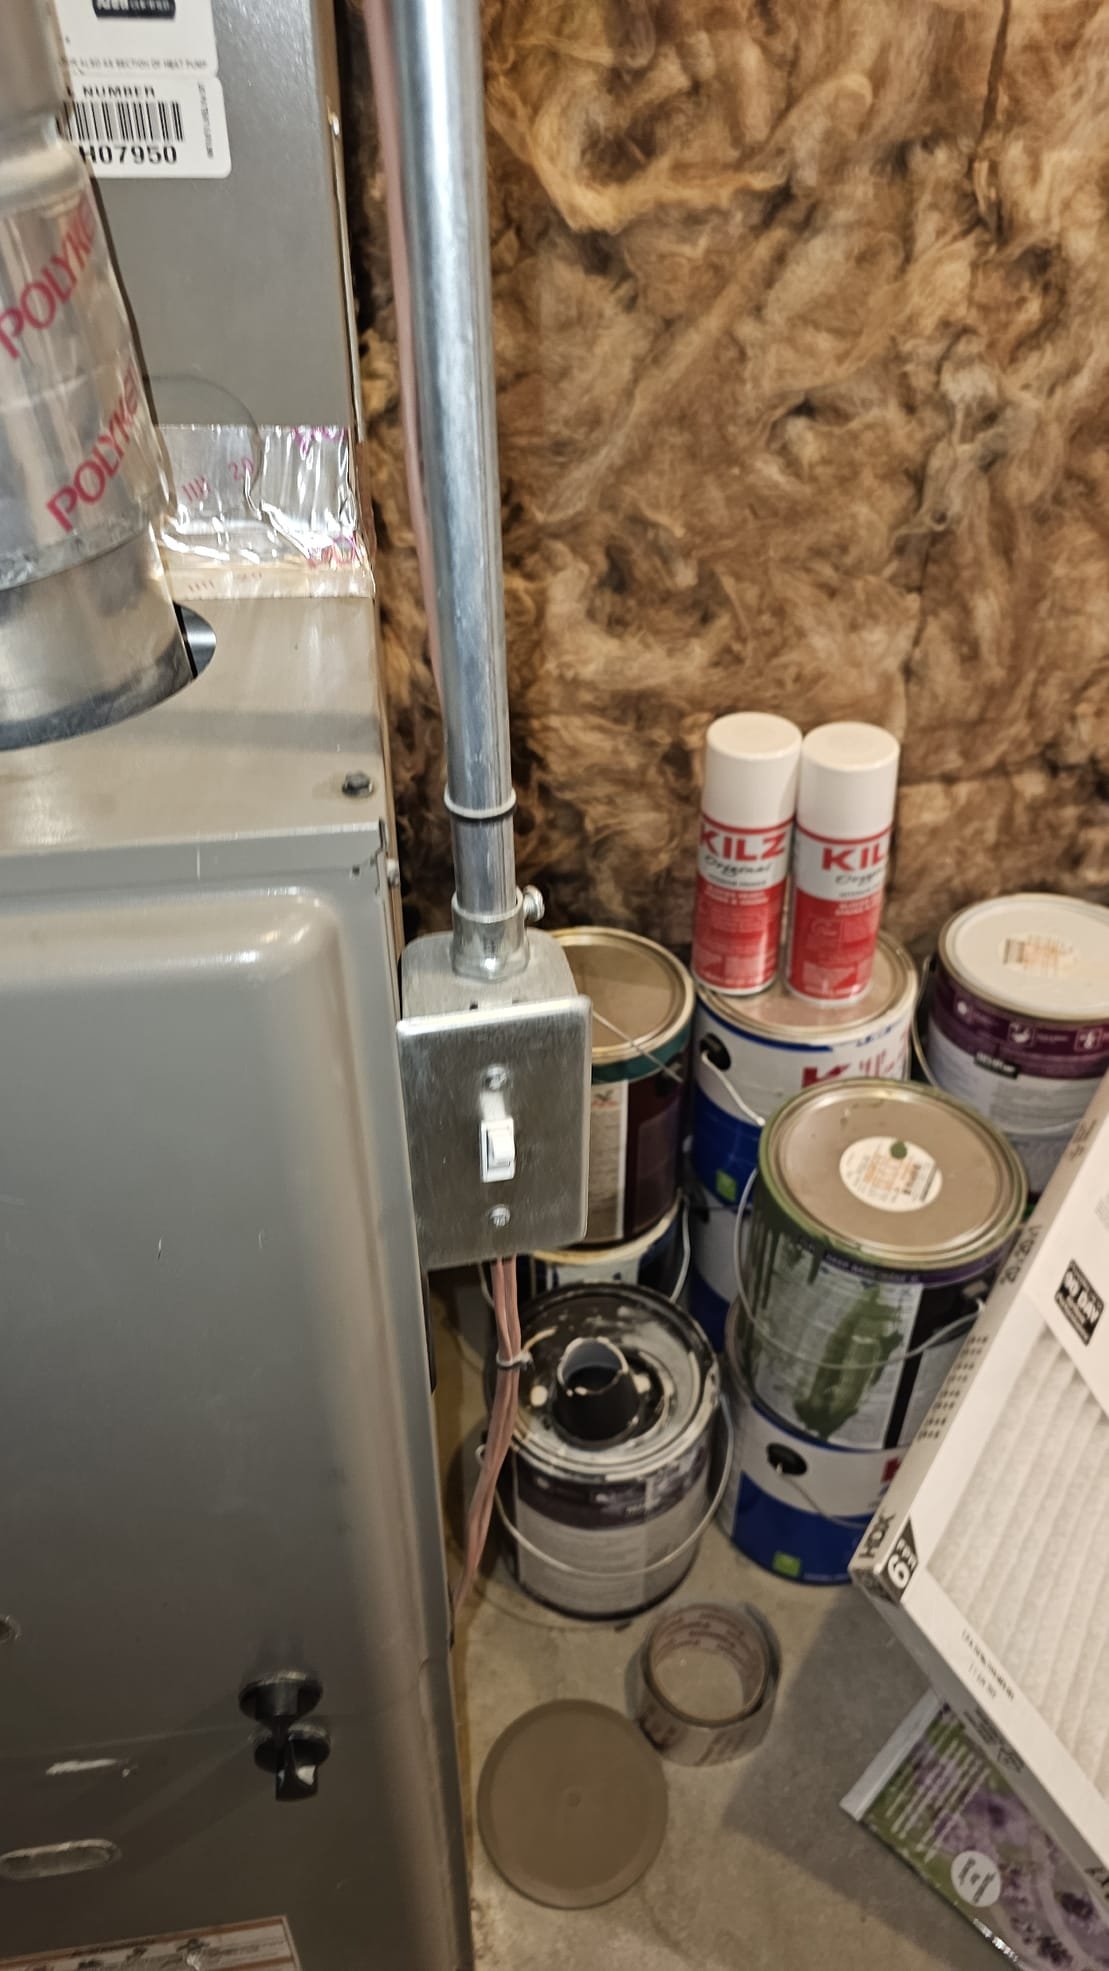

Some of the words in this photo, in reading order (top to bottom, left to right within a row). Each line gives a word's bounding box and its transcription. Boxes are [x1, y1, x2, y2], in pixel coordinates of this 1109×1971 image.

[82, 85, 156, 98] NUMBER
[700, 829, 786, 863] KILZ
[1077, 1289, 1100, 1325] DAY
[887, 1553, 910, 1589] 6
